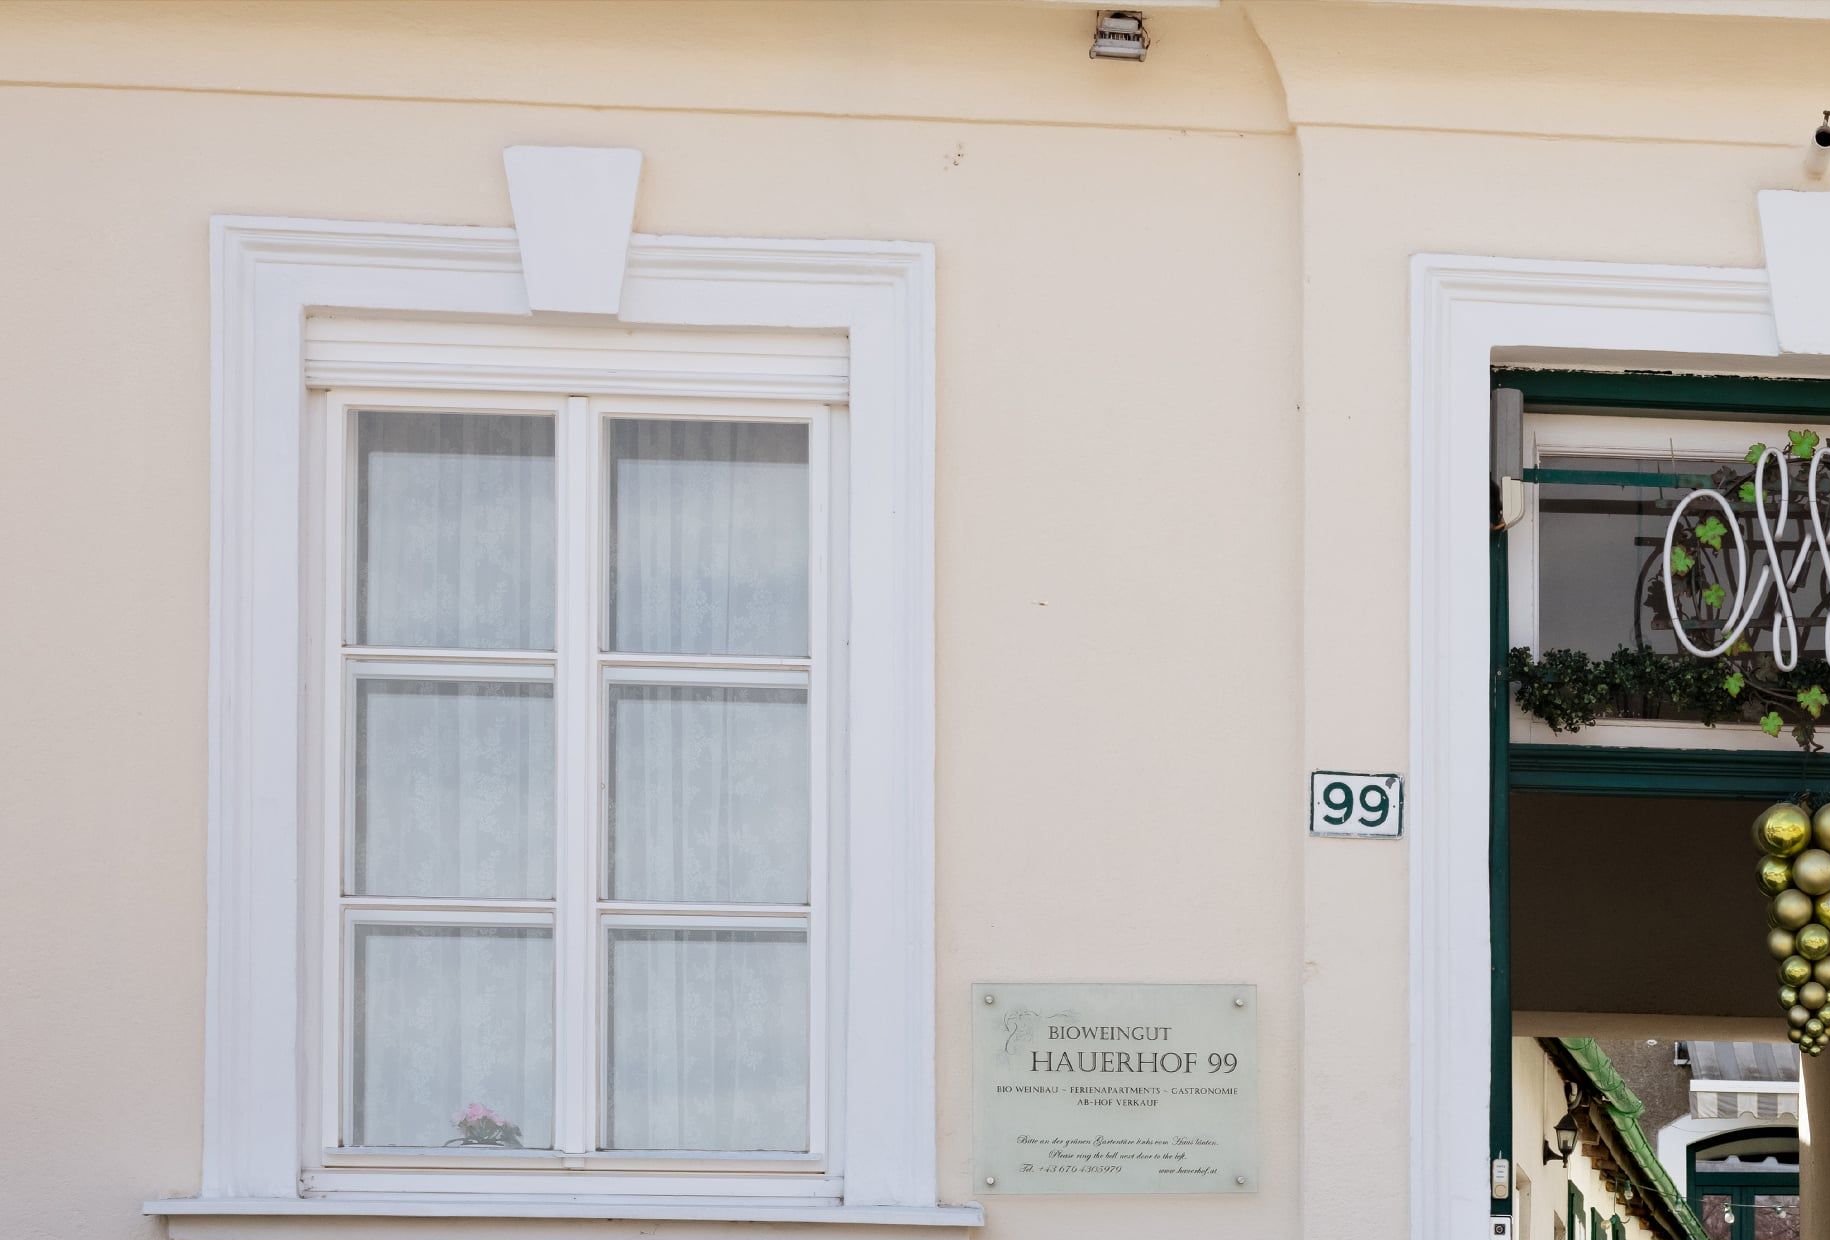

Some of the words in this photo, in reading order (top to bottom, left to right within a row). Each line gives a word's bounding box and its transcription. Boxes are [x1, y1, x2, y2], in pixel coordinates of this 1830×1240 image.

[1322, 781, 1390, 828] 99
[1048, 1025, 1173, 1041] BIOWEINGUT
[1029, 1051, 1198, 1074] HAUERHOF
[1207, 1052, 1238, 1074] 99
[997, 1085, 1013, 1094] BIO
[1016, 1086, 1059, 1094] WEINBAU
[1070, 1086, 1161, 1095] FERIENAPARTMENTS
[1171, 1087, 1239, 1095] GASTRONOMIE
[1077, 1098, 1114, 1106] AB-HOF
[1116, 1099, 1159, 1107] VERKAUF
